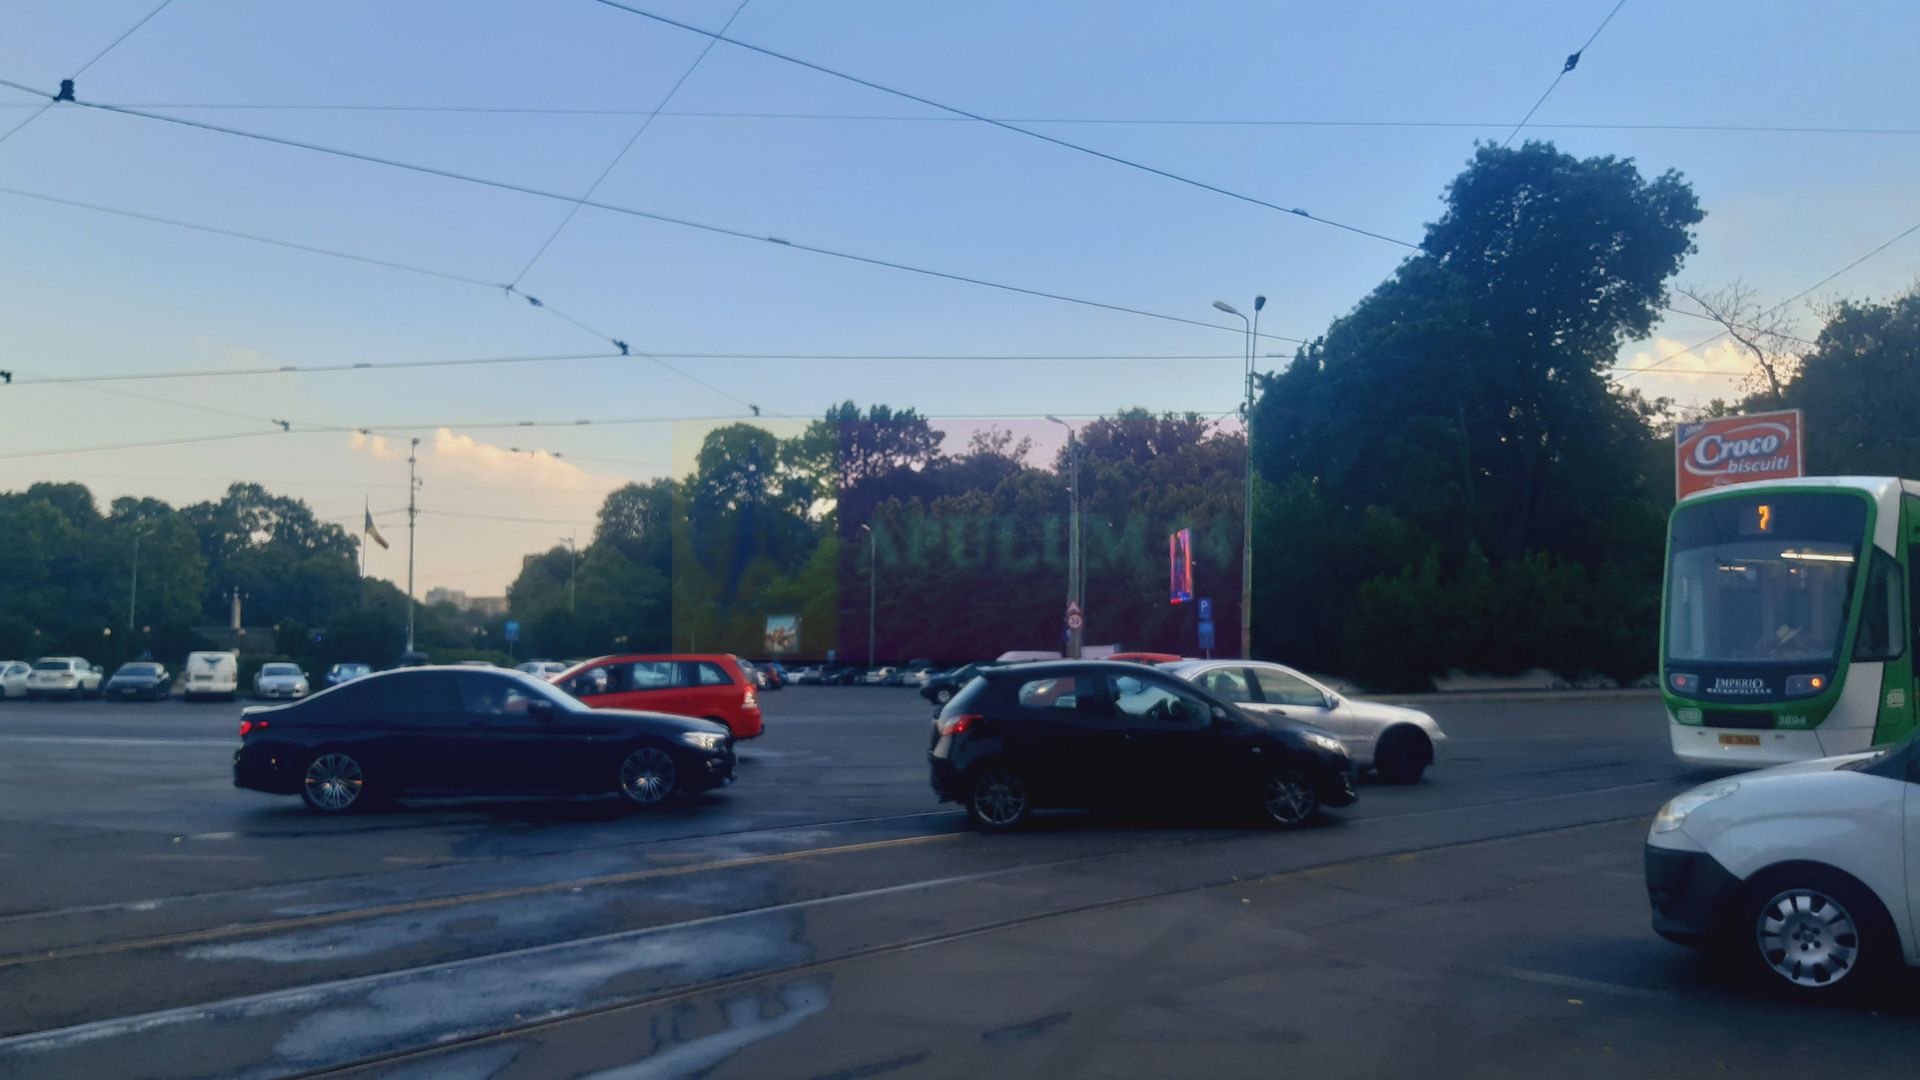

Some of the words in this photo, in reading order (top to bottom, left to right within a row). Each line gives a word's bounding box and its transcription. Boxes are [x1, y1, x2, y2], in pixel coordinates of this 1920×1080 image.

[1694, 434, 1778, 465] Croco
[1727, 456, 1789, 473] biscuiti
[1758, 505, 1770, 530] 7
[1715, 678, 1763, 689] IMPERIO
